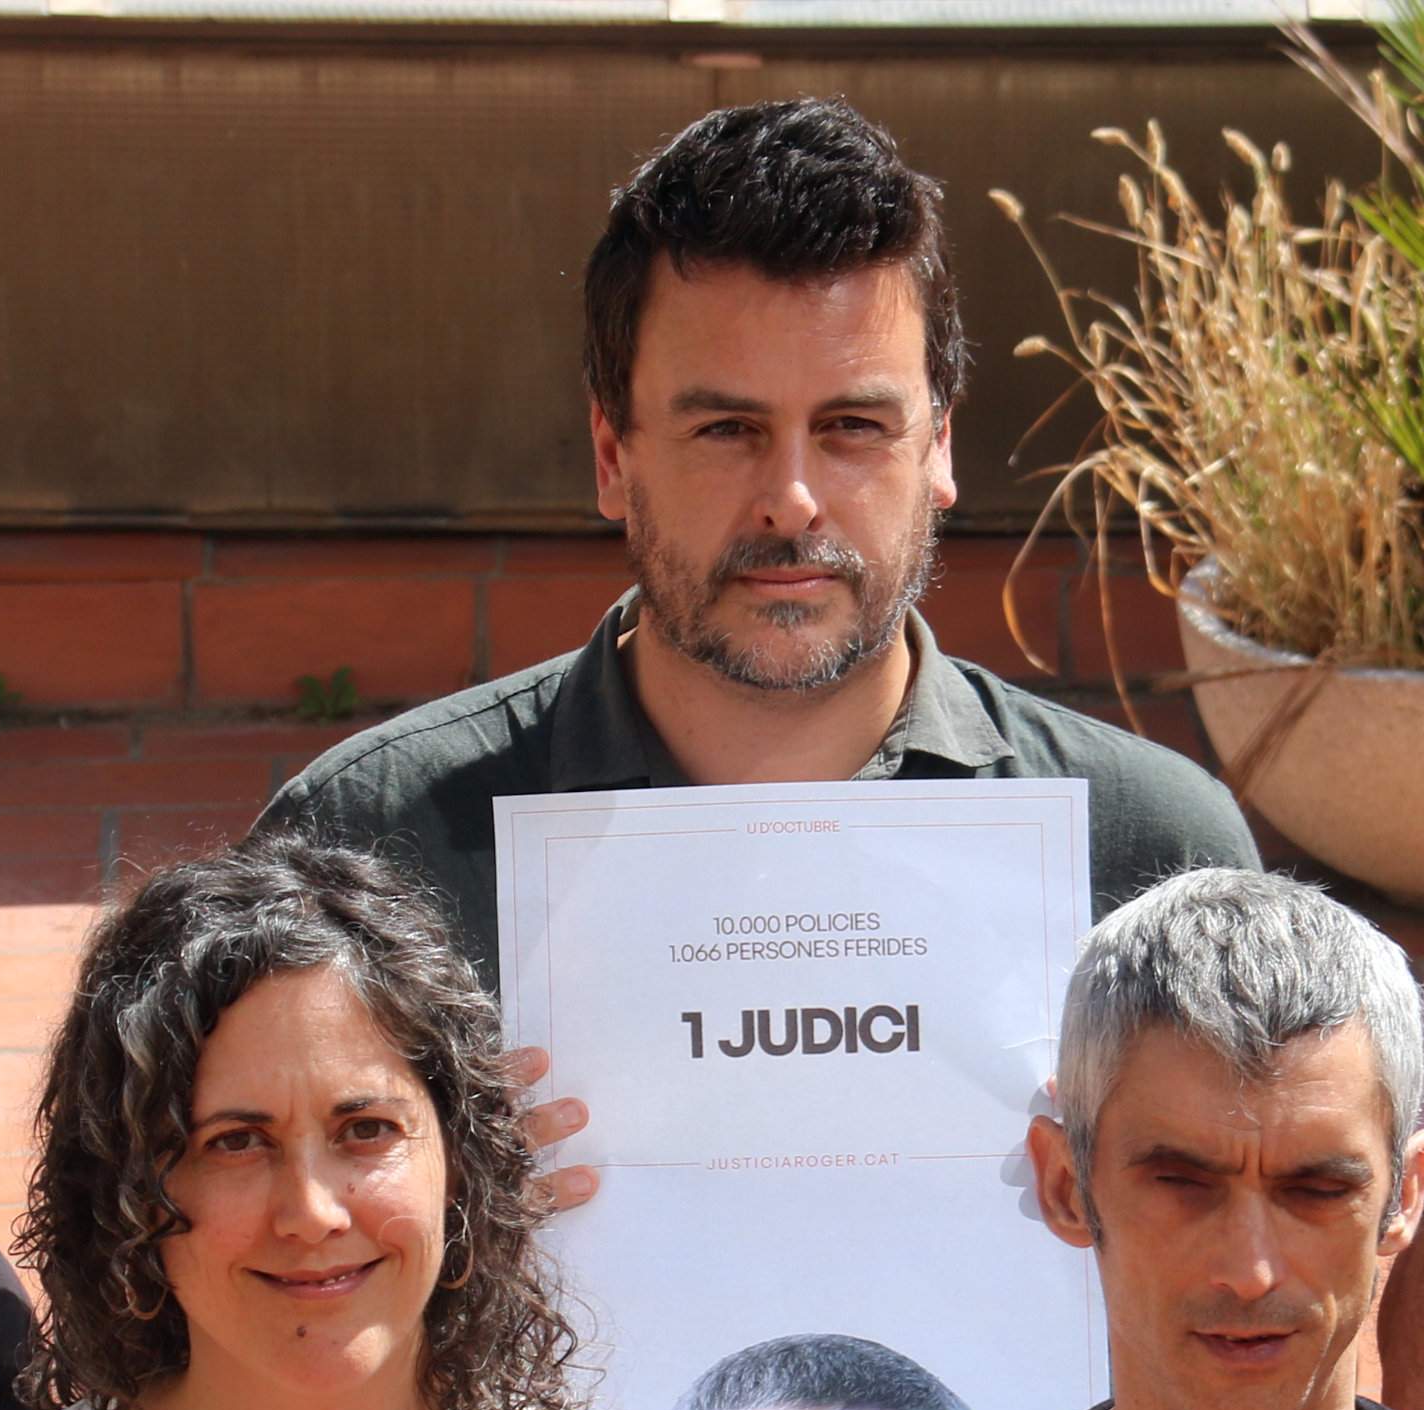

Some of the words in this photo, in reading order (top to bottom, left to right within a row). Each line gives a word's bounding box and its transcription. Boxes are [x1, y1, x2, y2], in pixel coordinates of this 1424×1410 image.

[747, 823, 756, 833] U
[760, 820, 840, 834] D'OCTUBRE
[713, 916, 781, 935] 10.000
[785, 913, 880, 932] POLICIES
[670, 944, 722, 962] 1.066
[727, 940, 839, 960] PERSONES
[844, 938, 927, 956] FERIDES
[681, 1012, 703, 1059] 1
[718, 1005, 920, 1058] JUDICI
[706, 1153, 900, 1170] JUSTICIAROGER.CAT
